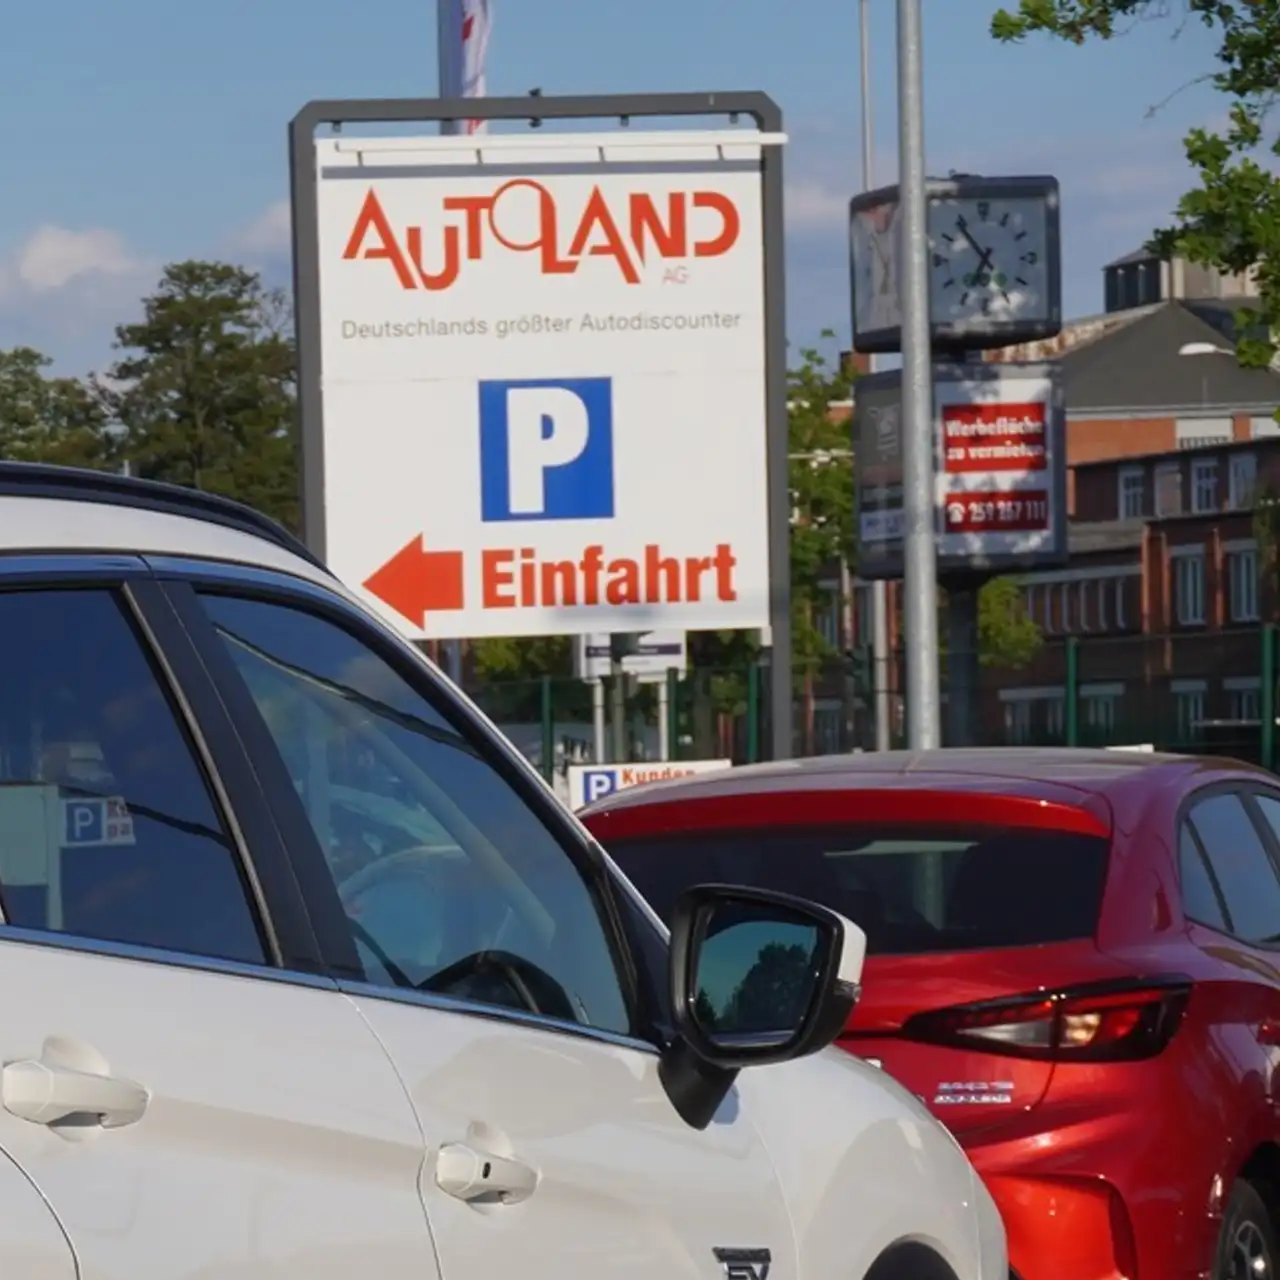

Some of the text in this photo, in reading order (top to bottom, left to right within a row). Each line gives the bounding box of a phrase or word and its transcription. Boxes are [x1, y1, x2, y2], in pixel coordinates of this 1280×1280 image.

[341, 178, 741, 291] AUTOLAND
[661, 266, 691, 286] AG
[341, 311, 742, 340] Deutschlands größter Autodiscounter
[506, 386, 590, 514] P
[481, 543, 738, 609] Einfahrt
